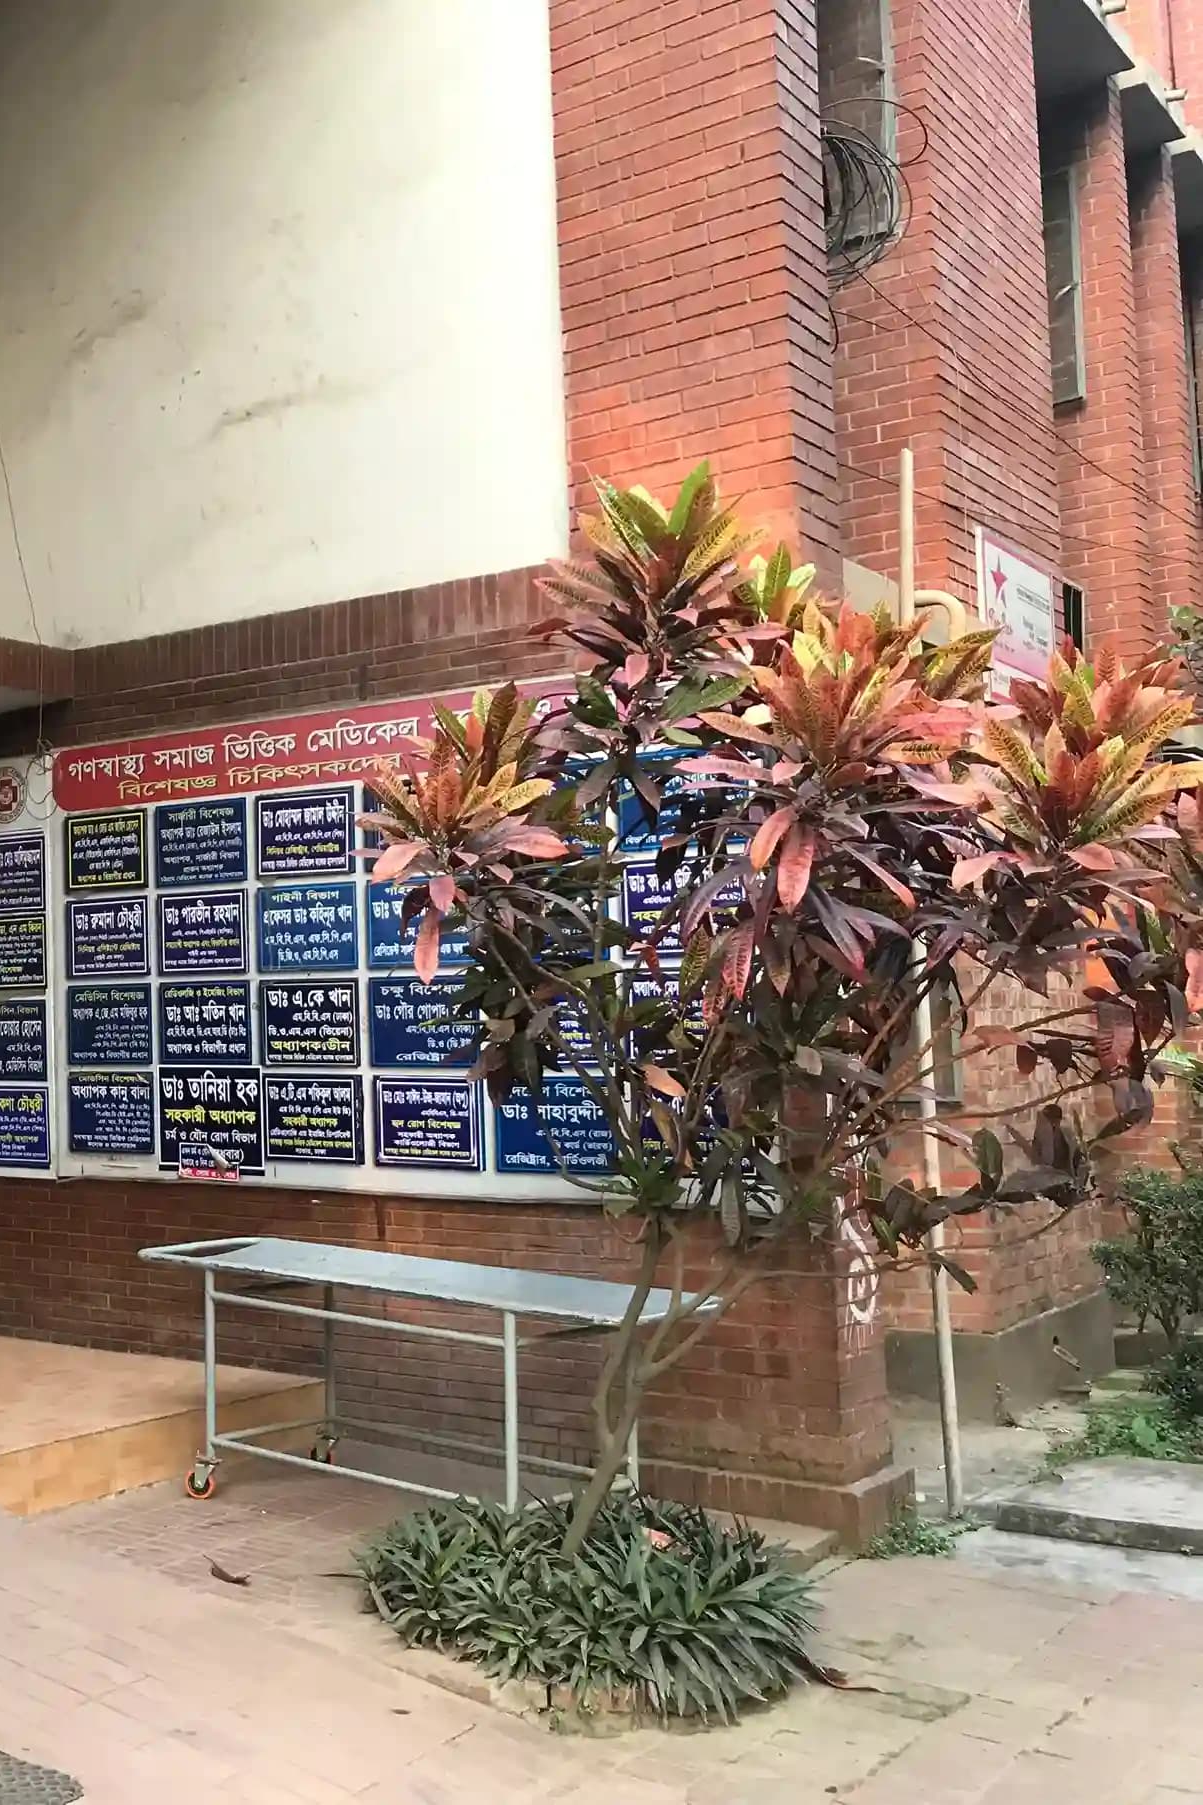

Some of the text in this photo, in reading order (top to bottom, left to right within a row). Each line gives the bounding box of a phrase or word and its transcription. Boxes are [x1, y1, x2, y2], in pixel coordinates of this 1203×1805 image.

[68, 752, 146, 782] গণস্বাস্থ্য
[152, 743, 214, 771] সমাজ
[221, 730, 296, 763] ভিত্তিক
[307, 716, 420, 751] মেডিকেল
[117, 773, 218, 800] বিশেষজ্ঞ
[627, 873, 645, 893] ডাঃ
[306, 890, 339, 900] বিভাগ
[75, 912, 88, 931] ডাঃ
[117, 904, 142, 931] চৌধুরী
[165, 905, 179, 925] ডাঃ
[212, 902, 239, 925] রহমান
[293, 907, 307, 924] ডাঃ
[337, 904, 352, 922] খান
[372, 900, 389, 919] ডাঃ
[267, 988, 288, 1008] ডাঃ
[328, 988, 351, 1008] খান
[165, 1000, 246, 1023] ডাঃ আঃ মতিন খান
[375, 1003, 391, 1020] ডাঃ
[71, 1085, 150, 1102] অধ্যাপক কানু বালা
[161, 1070, 258, 1106] ডাঃ তানিয়া হক
[17, 1092, 44, 1116] চৌধুরী
[501, 1104, 528, 1120] ডাঃ
[164, 1104, 206, 1124] সহকারী
[208, 1109, 256, 1125] অধ্যাপক
[164, 1126, 177, 1140] চর্ম
[189, 1128, 208, 1141] যৌন
[211, 1131, 229, 1142] রোগ
[231, 1129, 257, 1144] বিভাগ
